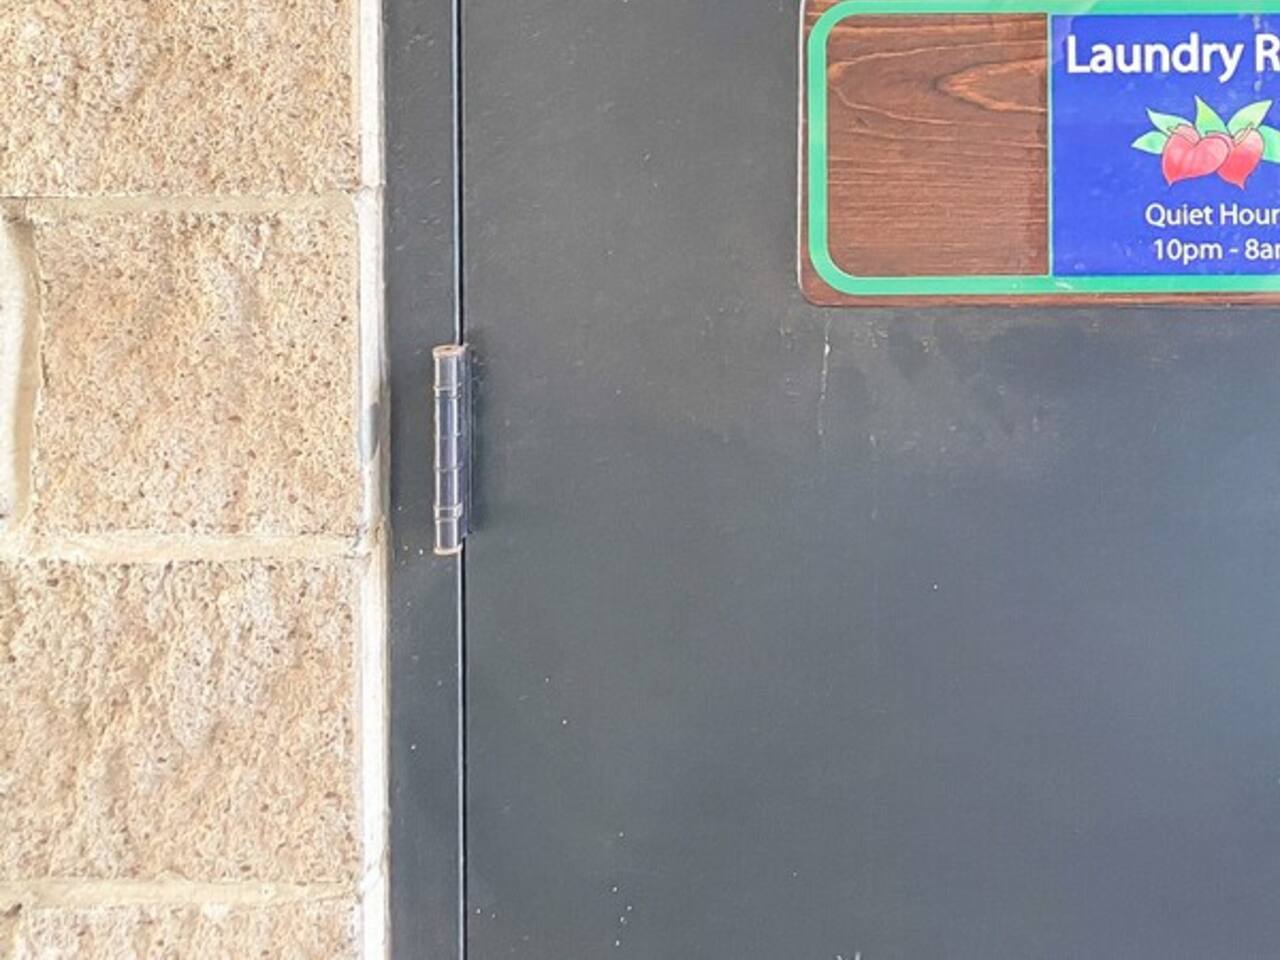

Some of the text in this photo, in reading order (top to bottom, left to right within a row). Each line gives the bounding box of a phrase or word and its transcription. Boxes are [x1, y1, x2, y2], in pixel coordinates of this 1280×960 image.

[1066, 32, 1244, 83] Laundry
[1144, 203, 1214, 227] Quiet
[1153, 238, 1223, 265] 10pm
